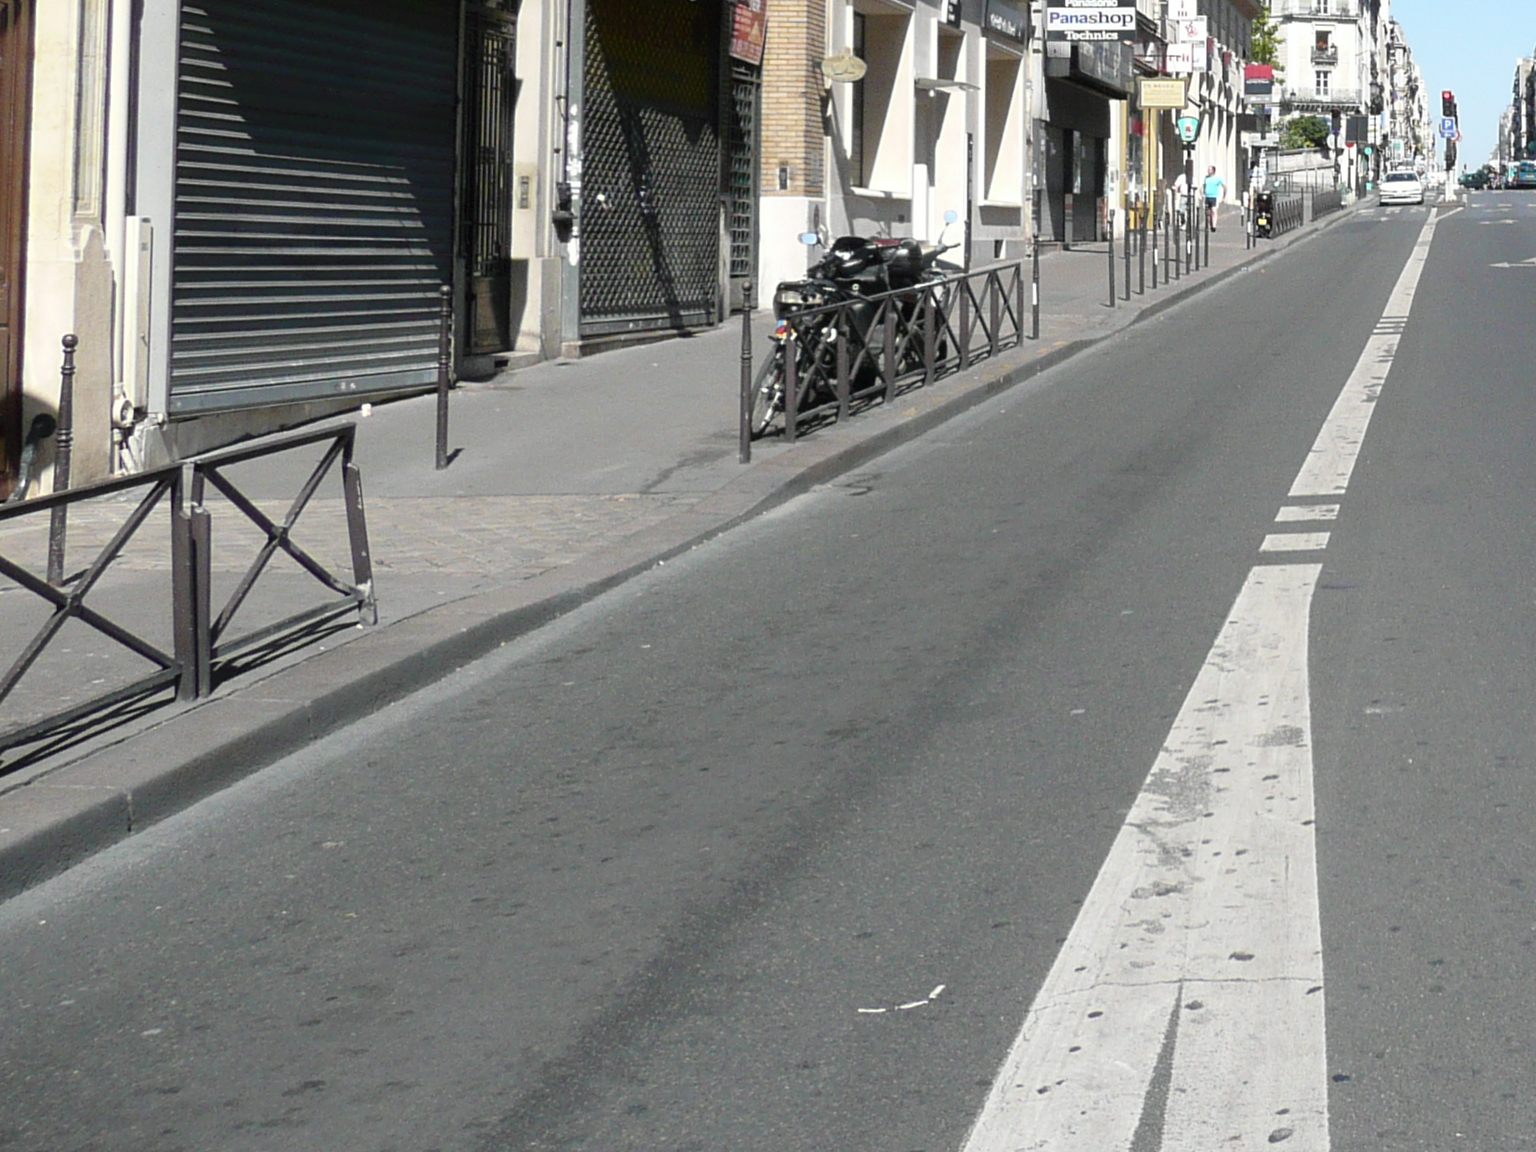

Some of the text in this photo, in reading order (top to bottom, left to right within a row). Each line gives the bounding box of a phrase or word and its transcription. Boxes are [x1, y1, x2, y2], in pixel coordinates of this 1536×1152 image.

[1049, 11, 1134, 27] Panashop
[1064, 30, 1119, 41] Technics
[1444, 119, 1452, 130] P
